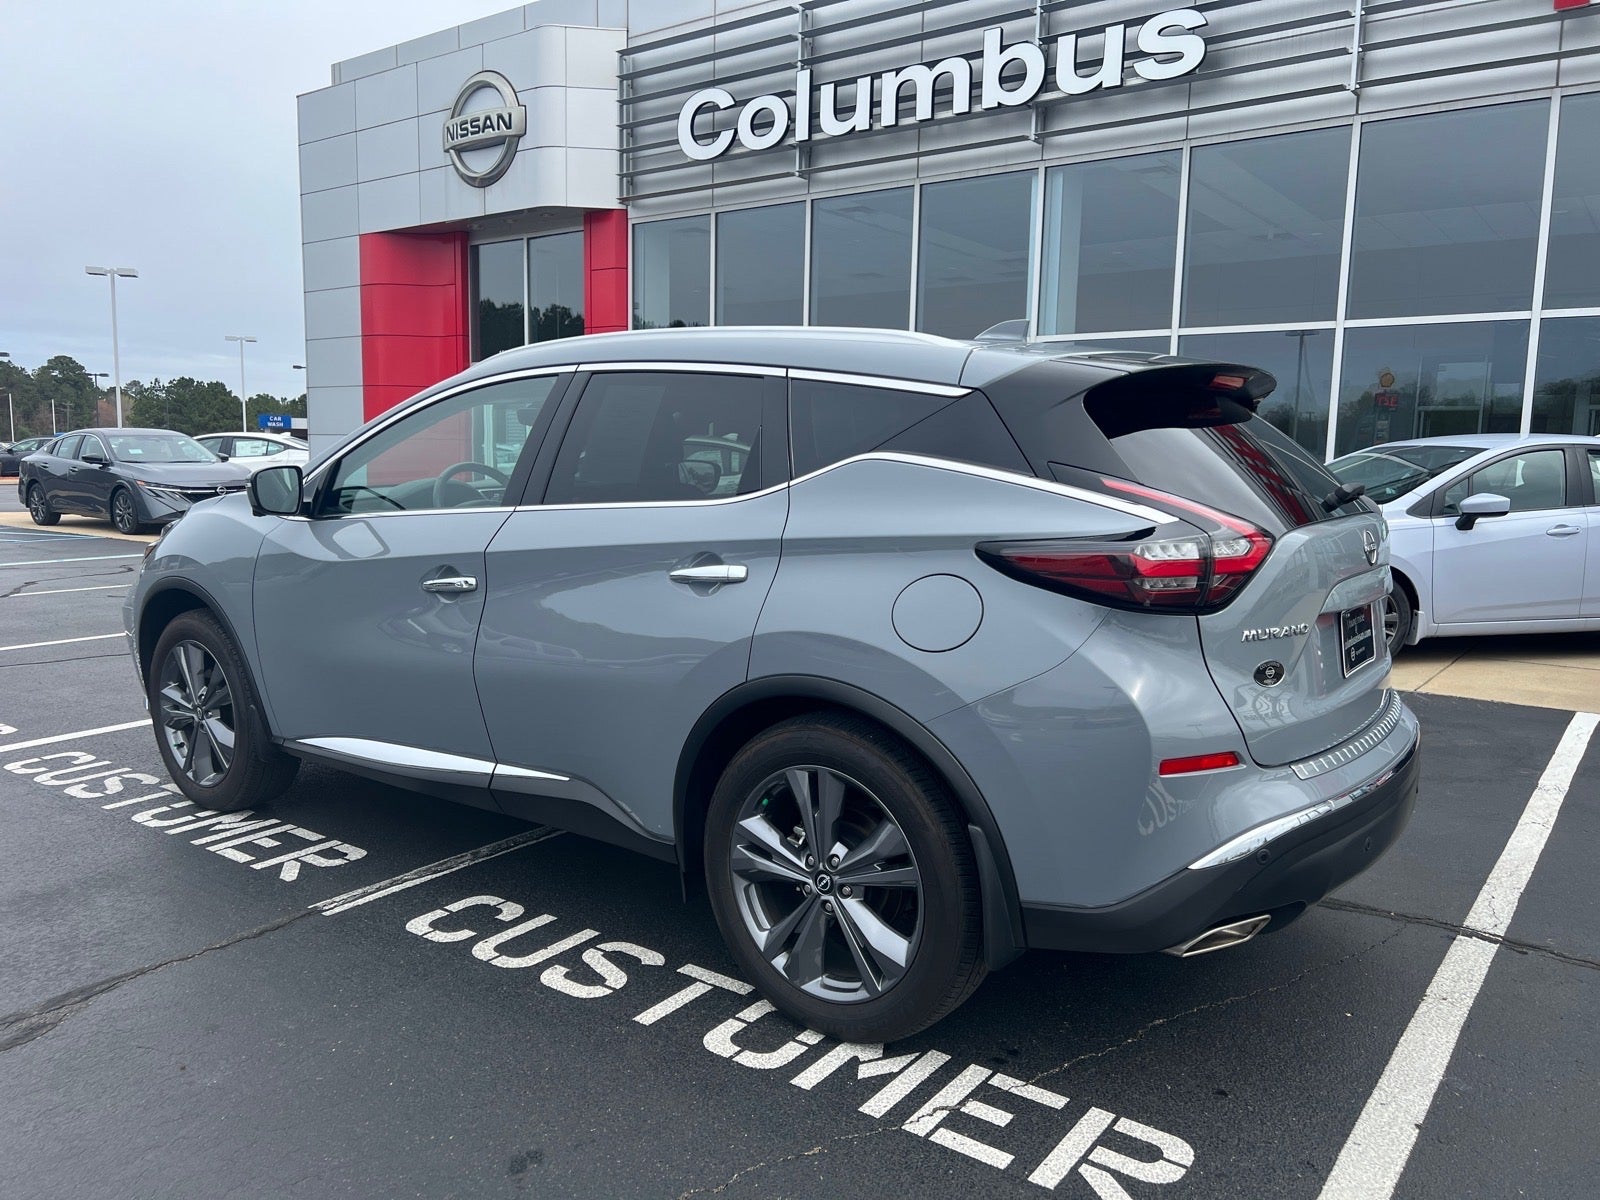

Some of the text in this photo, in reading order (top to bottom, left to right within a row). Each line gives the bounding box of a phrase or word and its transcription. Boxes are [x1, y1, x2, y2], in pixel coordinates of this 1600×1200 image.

[446, 112, 512, 143] NISSAN
[677, 9, 1209, 161] Columbus
[1241, 622, 1310, 643] MURANO
[3, 751, 367, 882] CUSTOMER
[405, 895, 1196, 1200] CUSTOMER
